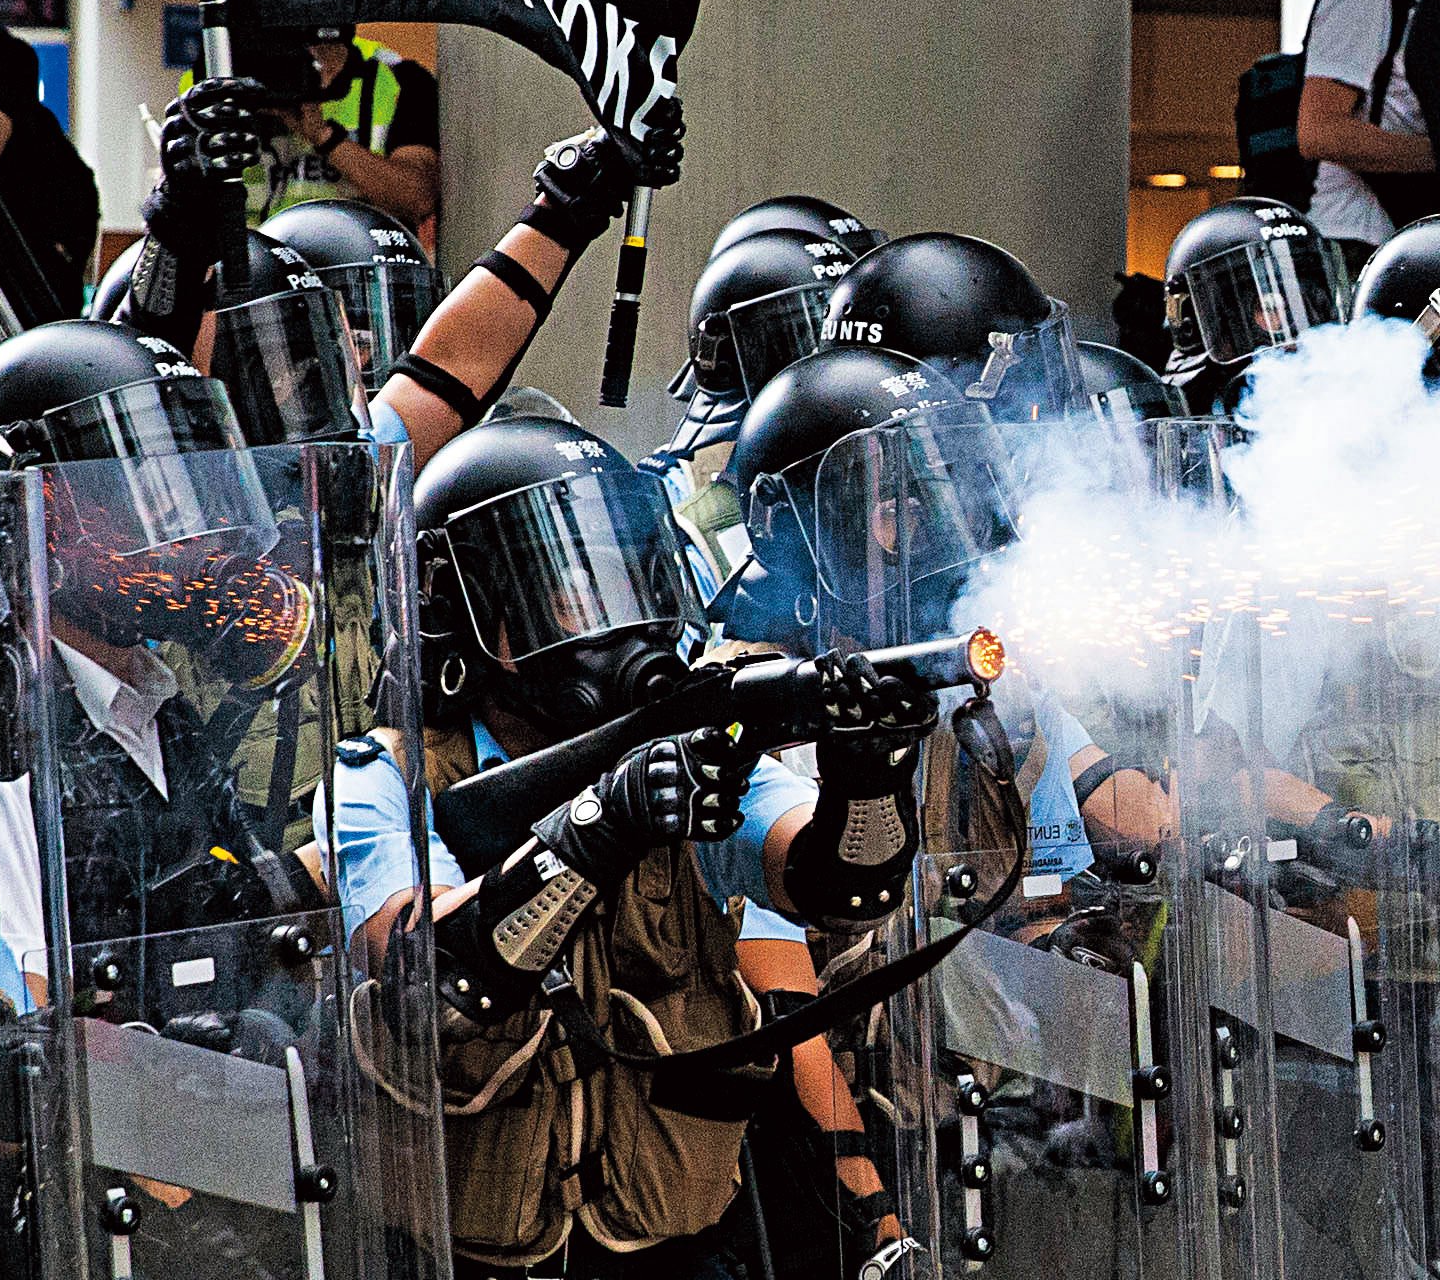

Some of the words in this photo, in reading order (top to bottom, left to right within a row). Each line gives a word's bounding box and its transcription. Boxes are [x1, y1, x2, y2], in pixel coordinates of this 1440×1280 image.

[1260, 223, 1308, 241] Police
[879, 371, 931, 398] 警察
[553, 439, 607, 461] 警察
